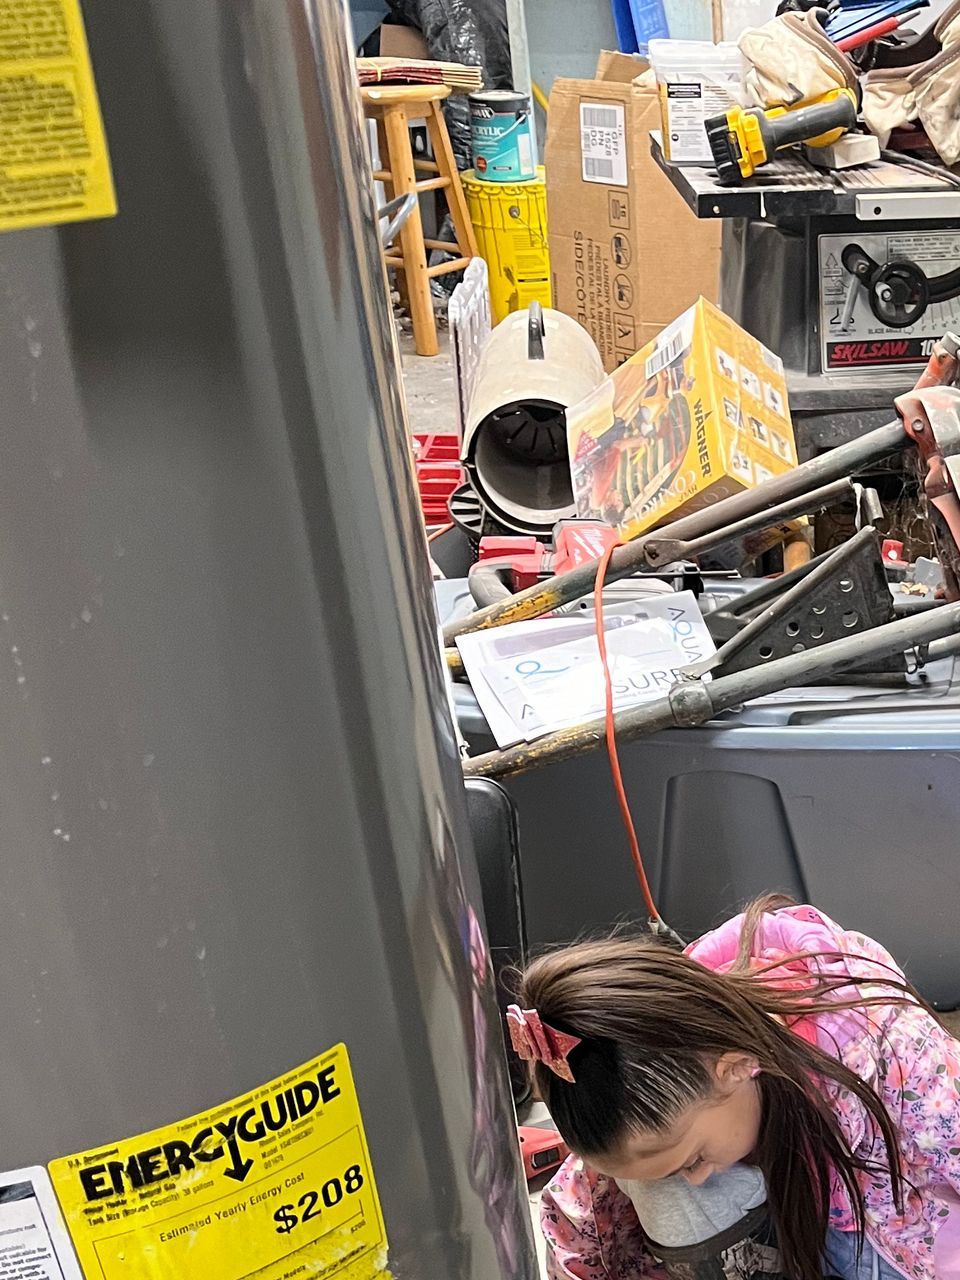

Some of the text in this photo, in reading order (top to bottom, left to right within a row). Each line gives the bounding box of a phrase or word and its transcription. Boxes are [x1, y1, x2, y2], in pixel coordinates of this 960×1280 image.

[597, 130, 604, 147] PN
[573, 231, 589, 324] SIDE/CÔTÉ
[603, 257, 614, 356] LAUNDRY PEDESTAL
[831, 341, 911, 360] SKILSAW
[693, 398, 712, 479] WAGNER
[667, 607, 703, 663] AQUA
[159, 1172, 306, 1242] Estimated Yearly Energy Cost
[272, 1164, 365, 1235] $208
